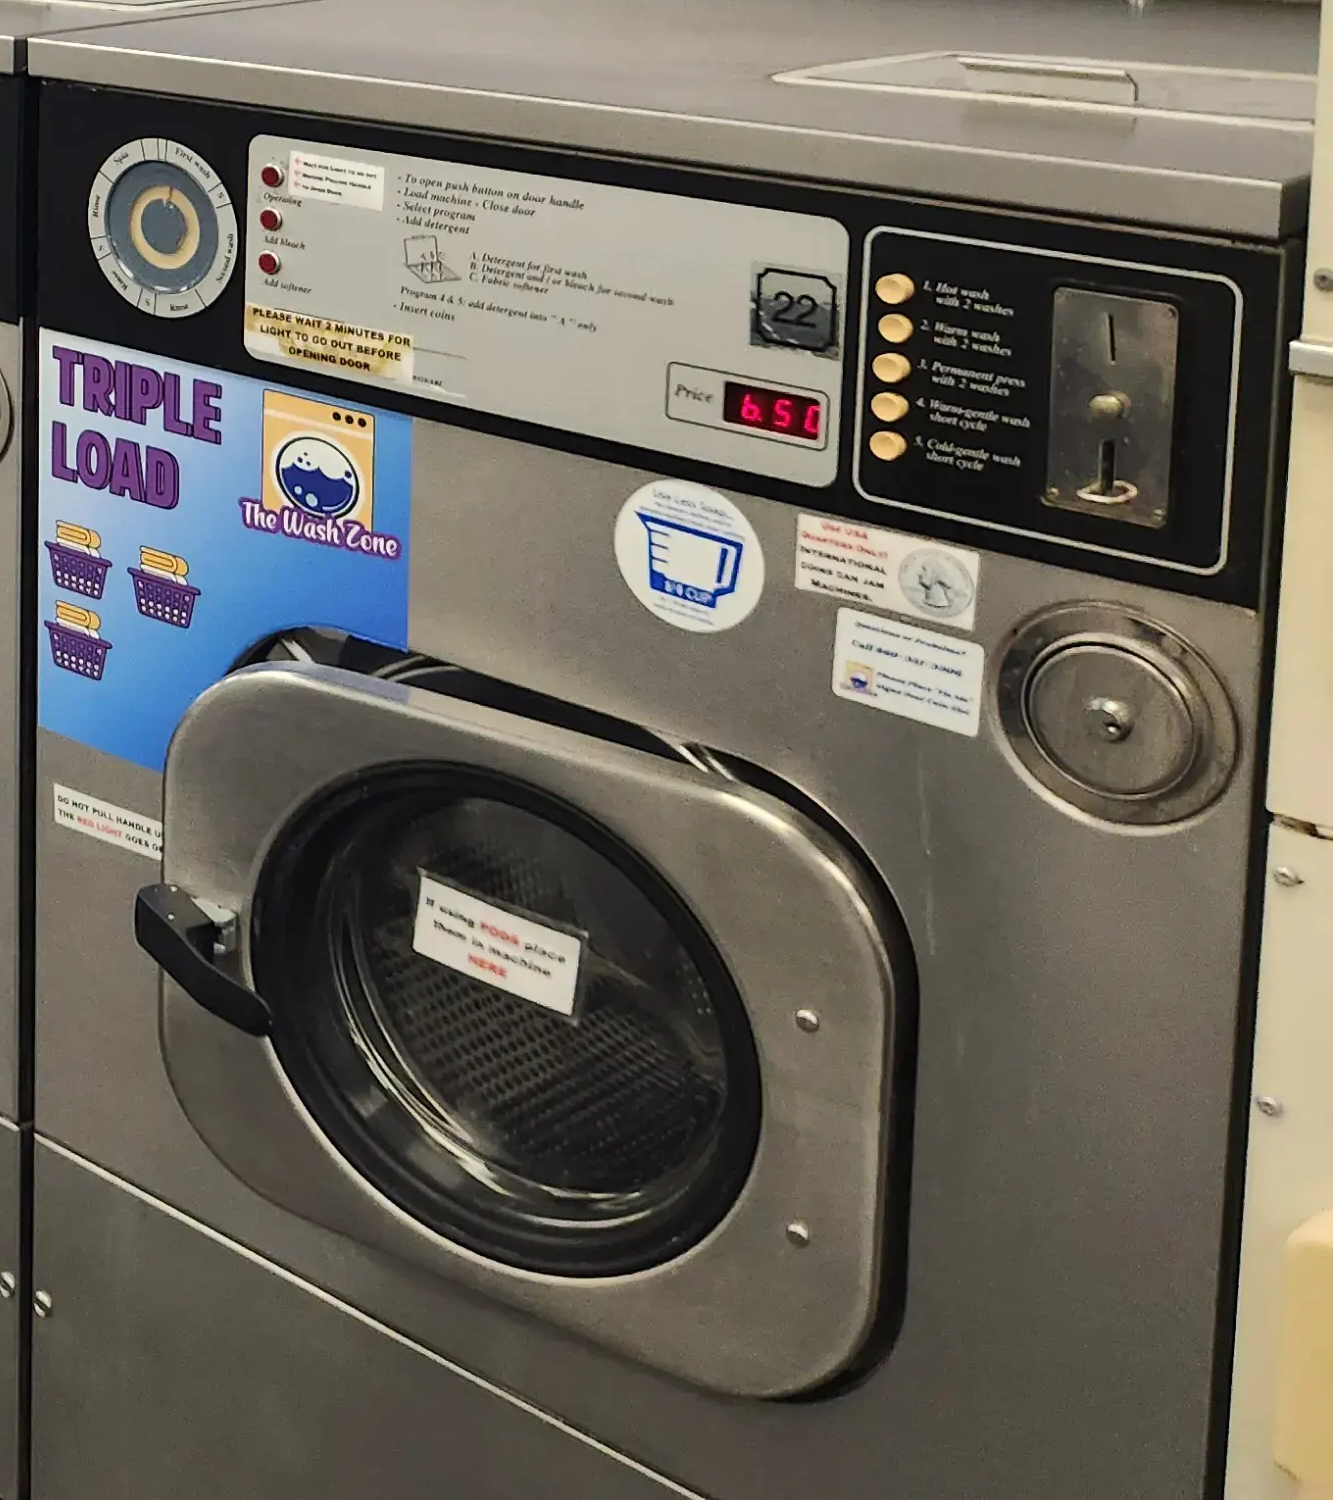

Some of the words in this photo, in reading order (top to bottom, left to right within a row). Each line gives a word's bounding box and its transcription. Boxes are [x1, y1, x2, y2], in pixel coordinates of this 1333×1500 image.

[174, 147, 193, 164] First
[193, 159, 212, 180] wash
[263, 192, 302, 208] Operating
[403, 188, 428, 200] Load
[431, 192, 472, 207] machine
[482, 200, 510, 213] Close
[512, 202, 536, 216] door
[405, 174, 417, 184] To
[419, 177, 443, 188] open
[445, 181, 469, 193] push
[472, 184, 504, 197] button
[506, 191, 520, 200] on
[522, 191, 546, 204] door
[549, 195, 585, 211] handle
[403, 201, 432, 215] Select
[433, 206, 476, 222] program
[403, 215, 422, 227] Add
[424, 218, 470, 235] detergent
[264, 235, 278, 245] Add
[280, 238, 305, 250] bleach
[482, 253, 525, 268] Detergent
[527, 260, 541, 271] for
[564, 269, 588, 279] wash
[482, 264, 525, 280] Detergent
[263, 278, 279, 288] Add
[279, 281, 312, 294] softener
[935, 283, 959, 297] Hot
[960, 287, 990, 301] wash
[399, 302, 427, 316] Insert
[430, 309, 456, 322] coins
[400, 286, 438, 302] Program
[468, 299, 485, 311] add
[486, 302, 527, 319] detergent
[770, 290, 819, 329] 22
[935, 295, 961, 309] with
[962, 299, 972, 311] 2
[973, 302, 1014, 318] washes
[252, 307, 292, 323] PLEASE
[295, 315, 321, 329] WAIT
[325, 322, 332, 331] 2
[334, 324, 384, 341] MINUTES
[388, 333, 410, 347] FOR
[934, 322, 969, 338] Warm
[970, 328, 1001, 343] wash
[260, 324, 291, 339] LIGHT
[296, 331, 309, 342] TO
[312, 335, 327, 346] GO
[330, 339, 353, 351] OUT
[356, 344, 401, 361] BEFORE
[933, 335, 959, 350] with
[960, 338, 970, 351] 2
[971, 342, 1013, 357] washes
[289, 346, 337, 364] OPENING
[340, 357, 371, 371] DOOR
[931, 361, 994, 382] Permanent
[995, 373, 1027, 389] press
[931, 373, 957, 388] with
[958, 378, 968, 389] 2
[969, 381, 1011, 397] washes
[52, 345, 223, 445] TRIPLE
[674, 383, 715, 403] Price
[929, 411, 958, 426] short
[959, 416, 988, 432] cycle
[1000, 414, 1031, 429] wash
[51, 420, 180, 510] LOAD
[926, 450, 955, 465] short
[956, 457, 985, 472] cycle
[992, 453, 1022, 467] wash
[242, 501, 277, 531] The
[282, 510, 339, 544] Wash
[340, 522, 399, 557] Zone
[845, 527, 868, 540] USA
[800, 545, 887, 575] INTERNATIONAL
[836, 570, 858, 583] CAN
[863, 578, 885, 590] JAM
[58, 808, 74, 821] THE
[77, 815, 94, 828] RED
[96, 822, 123, 838] LIGHT
[125, 833, 149, 849] GOES
[72, 801, 90, 812] NOT
[92, 807, 114, 821] PULL
[116, 816, 152, 836] HANDLE
[439, 906, 475, 929] using
[480, 920, 521, 946] PODS
[524, 942, 566, 964] place
[433, 919, 467, 941] them
[471, 936, 485, 950] in
[488, 945, 552, 978] machine
[467, 952, 508, 978] HERE
